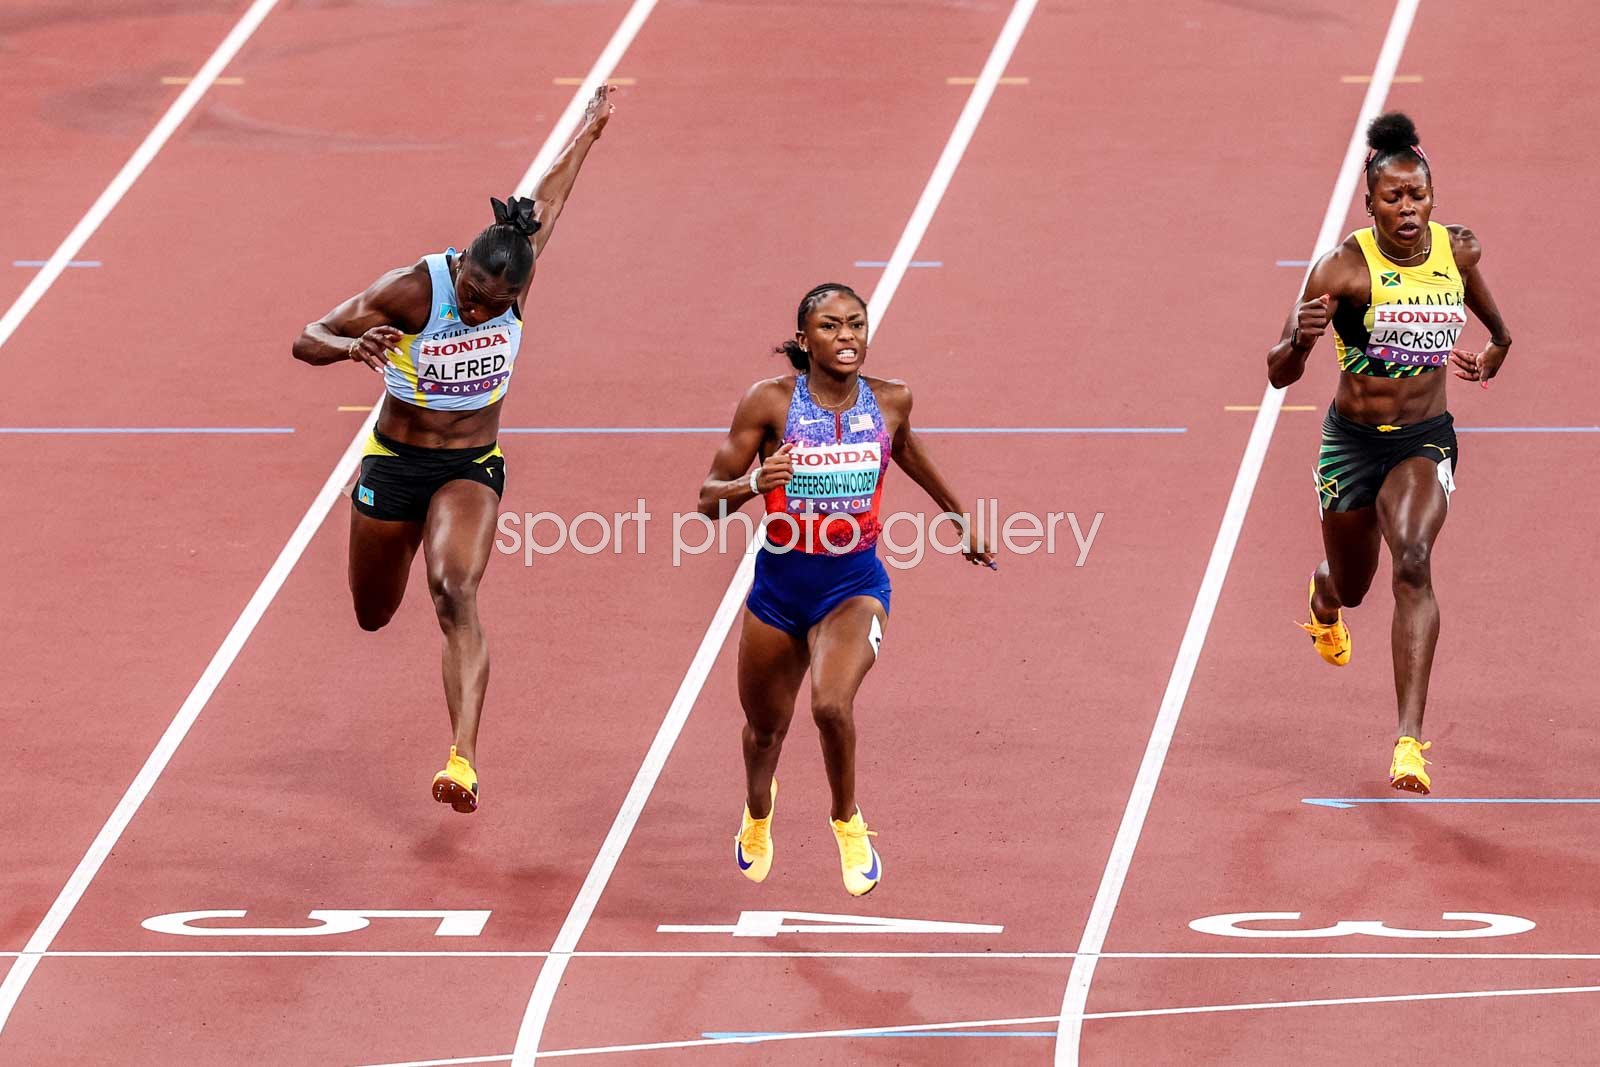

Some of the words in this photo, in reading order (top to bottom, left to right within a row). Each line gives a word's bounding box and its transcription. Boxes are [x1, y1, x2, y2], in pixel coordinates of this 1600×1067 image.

[1377, 311, 1465, 323] HONDA
[422, 333, 508, 357] HONDA
[1375, 328, 1457, 349] JACKSON
[424, 354, 506, 380] ALFRED
[788, 450, 879, 467] HONDA
[787, 471, 877, 495] JEFFERSON-WOODEN
[140, 909, 493, 937] 5
[656, 910, 1005, 937] 4
[1188, 911, 1537, 939] 3
